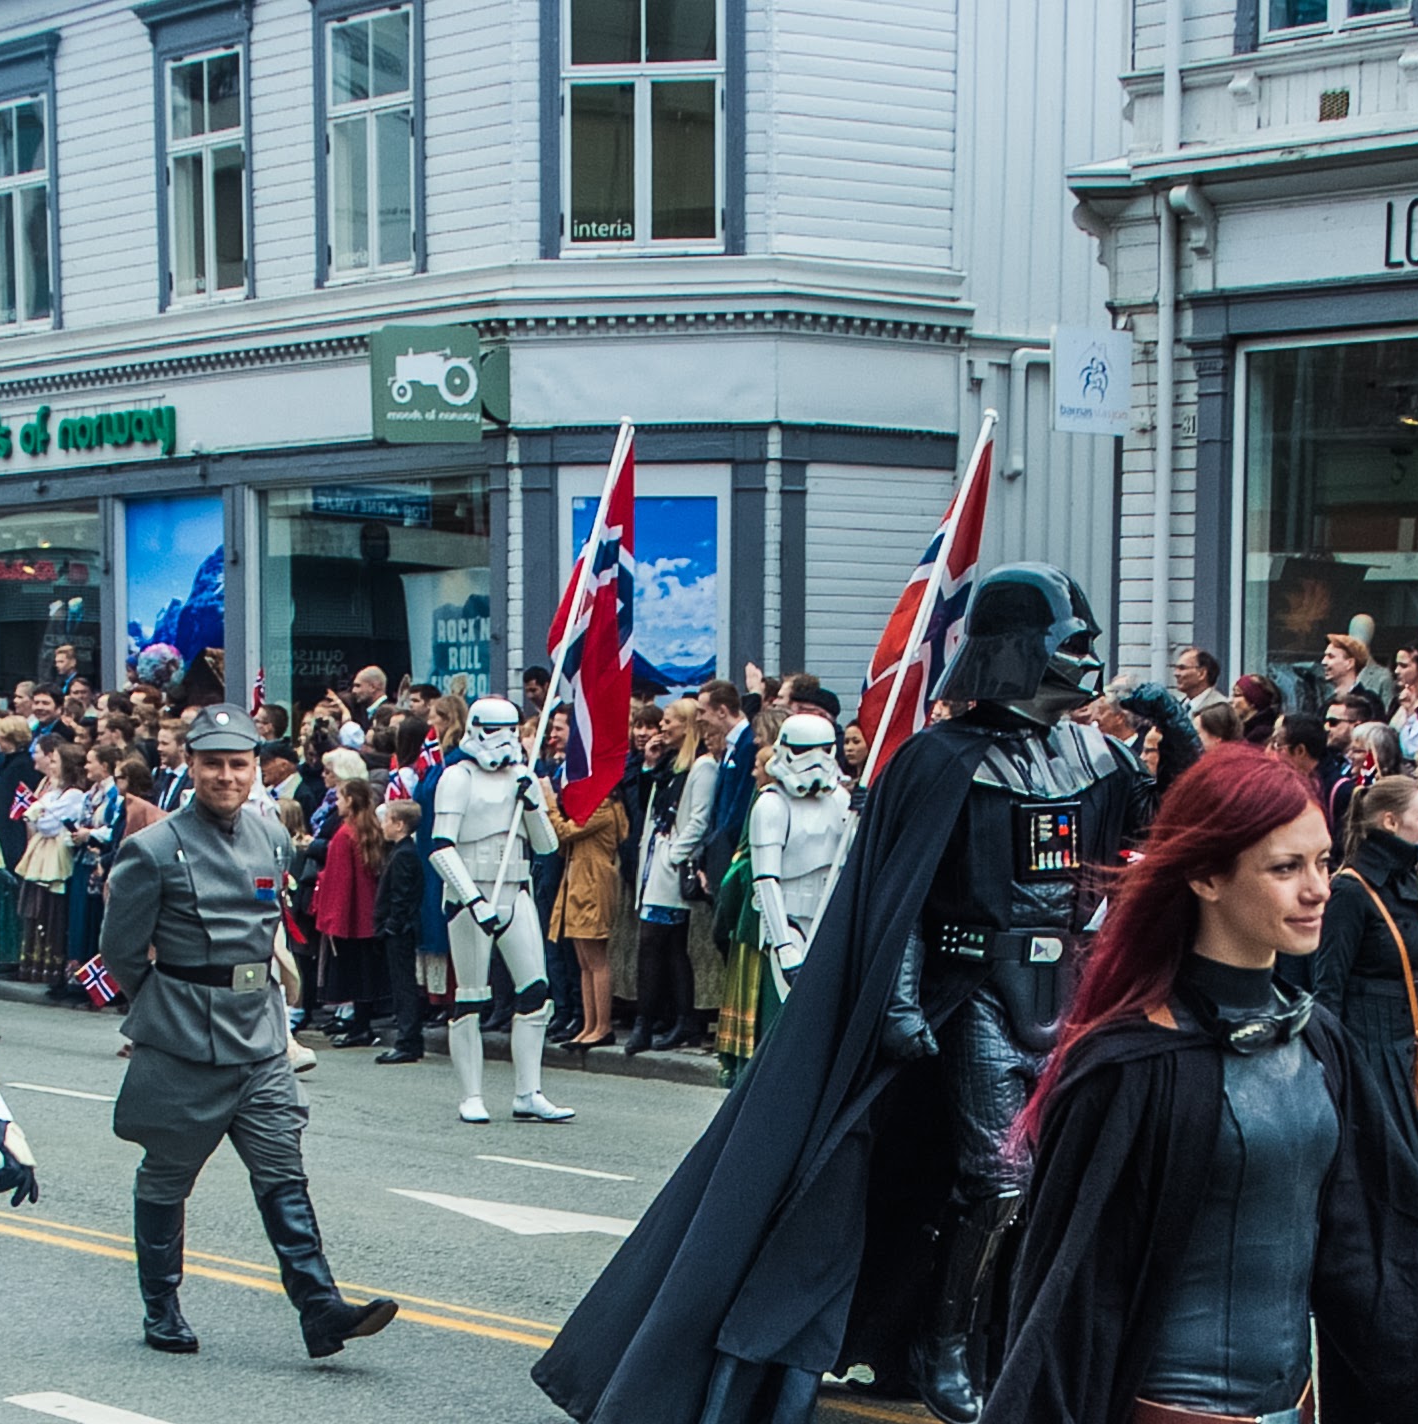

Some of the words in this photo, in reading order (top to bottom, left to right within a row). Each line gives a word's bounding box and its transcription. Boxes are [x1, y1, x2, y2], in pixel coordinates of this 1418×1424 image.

[573, 219, 632, 237] interia
[19, 405, 51, 456] of
[58, 406, 176, 456] norway
[449, 646, 481, 670] ROLL
